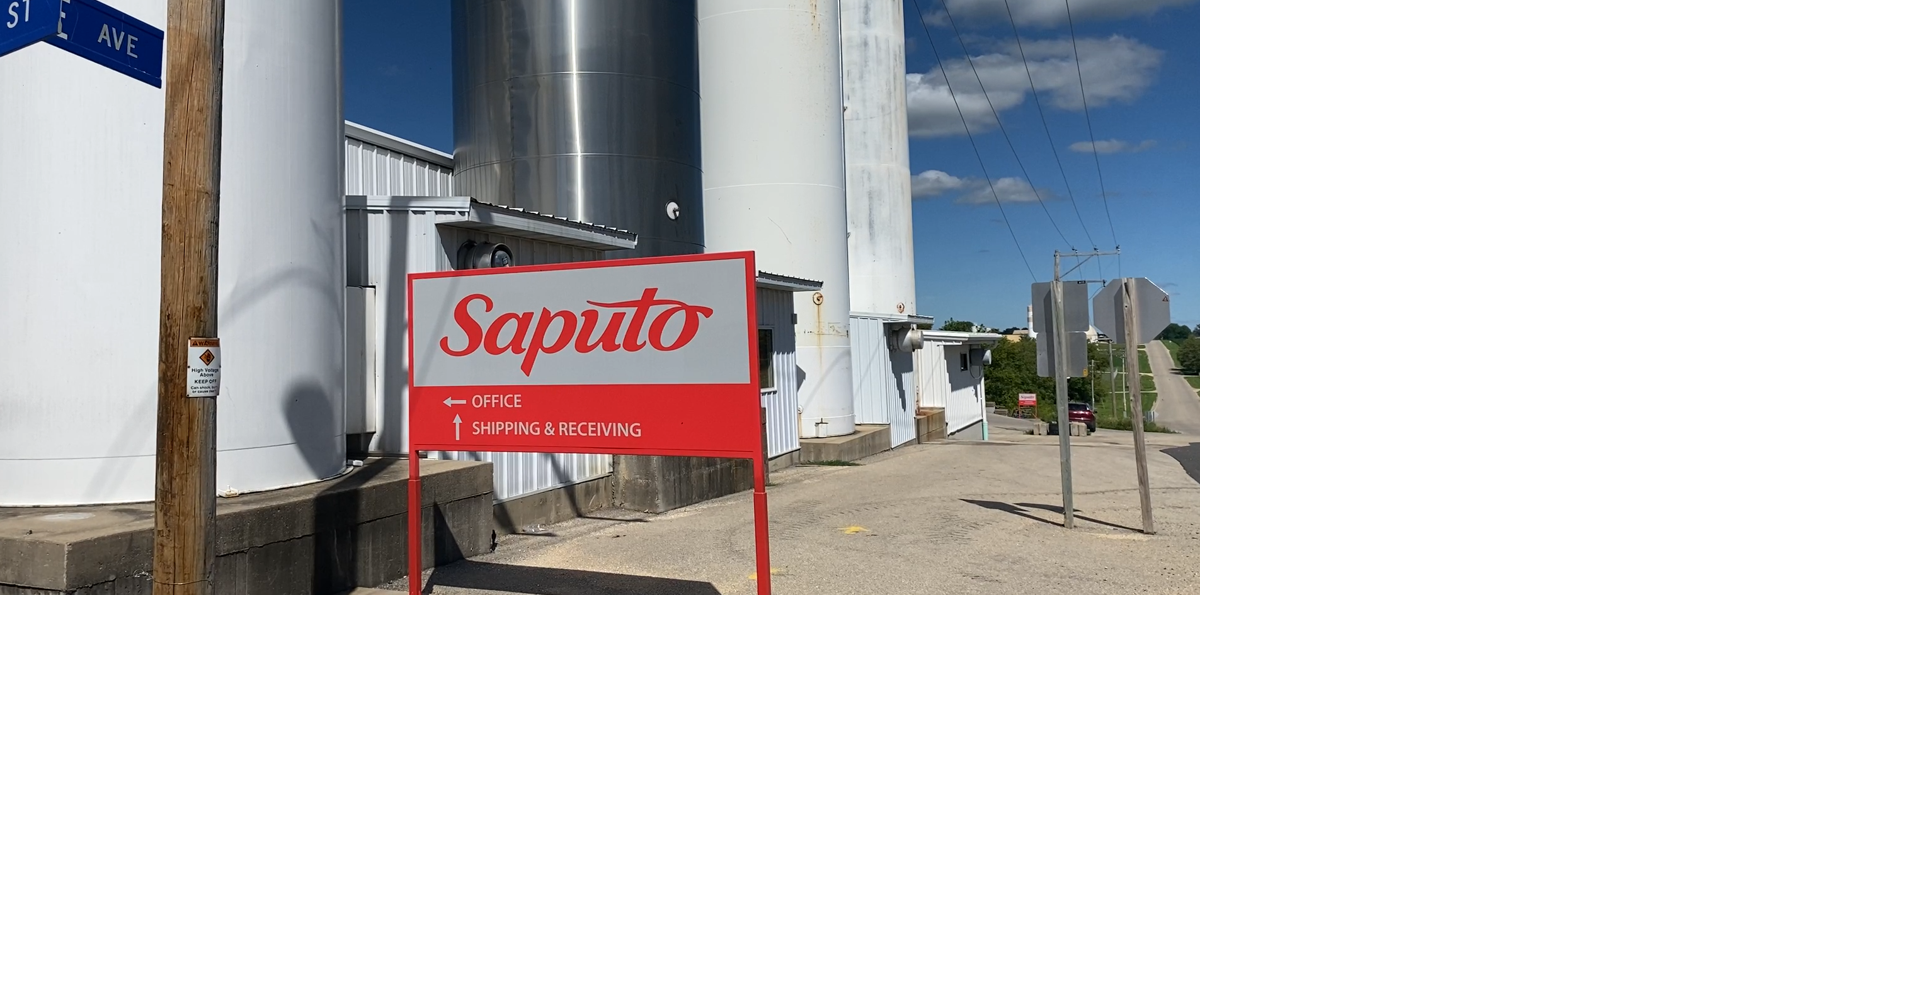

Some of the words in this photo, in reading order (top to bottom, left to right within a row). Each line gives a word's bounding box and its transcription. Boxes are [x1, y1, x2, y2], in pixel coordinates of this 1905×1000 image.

[6, 0, 30, 28] ST
[97, 23, 139, 58] AVE
[439, 287, 714, 377] Saputo
[471, 394, 522, 408] OFFICE
[472, 421, 541, 436] SHIPPING
[544, 422, 555, 436] &
[558, 422, 642, 437] RECEIVING
